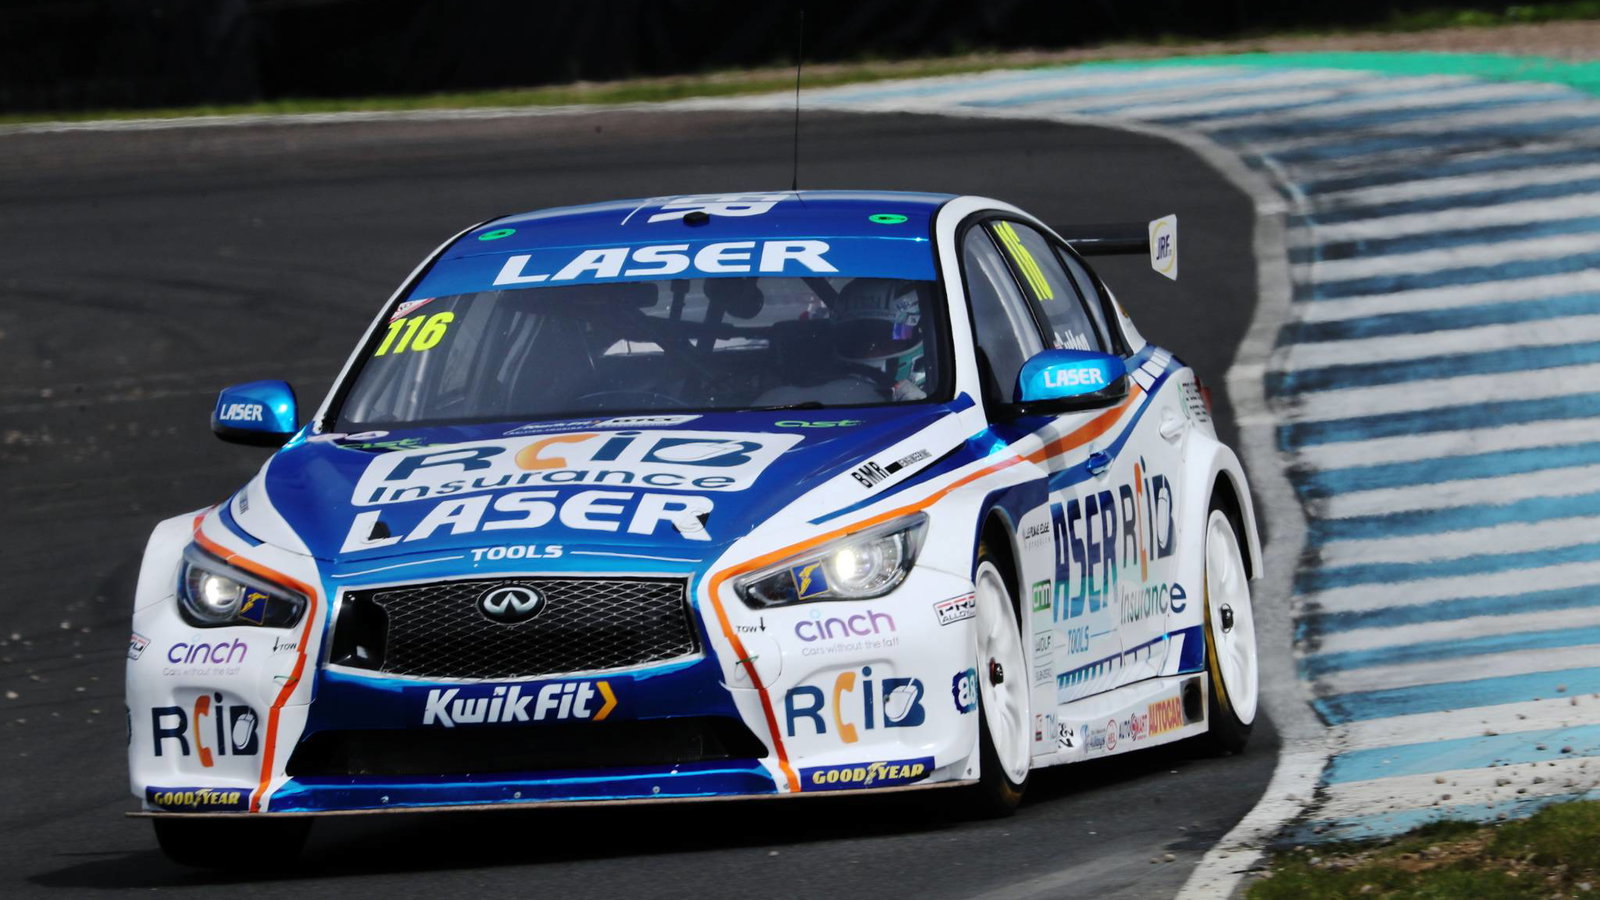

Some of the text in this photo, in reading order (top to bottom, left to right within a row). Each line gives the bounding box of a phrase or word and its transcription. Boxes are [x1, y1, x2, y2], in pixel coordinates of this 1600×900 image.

[492, 240, 839, 285] LASER
[374, 312, 455, 357] 116
[1044, 368, 1104, 388] LASER
[220, 404, 263, 421] LASER
[369, 470, 737, 503] Insurance
[851, 461, 889, 488] BMR
[339, 490, 714, 554] LASER
[470, 544, 564, 561] TOOLS
[1119, 582, 1187, 625] Insurance
[737, 624, 758, 634] TOW
[794, 609, 896, 642] cinch
[168, 634, 248, 664] cinch
[1068, 626, 1090, 656] TOOLS
[1148, 696, 1184, 736] AUTOCAR
[812, 762, 925, 785] GOODYEAR
[154, 788, 241, 807] GOODYEAR
